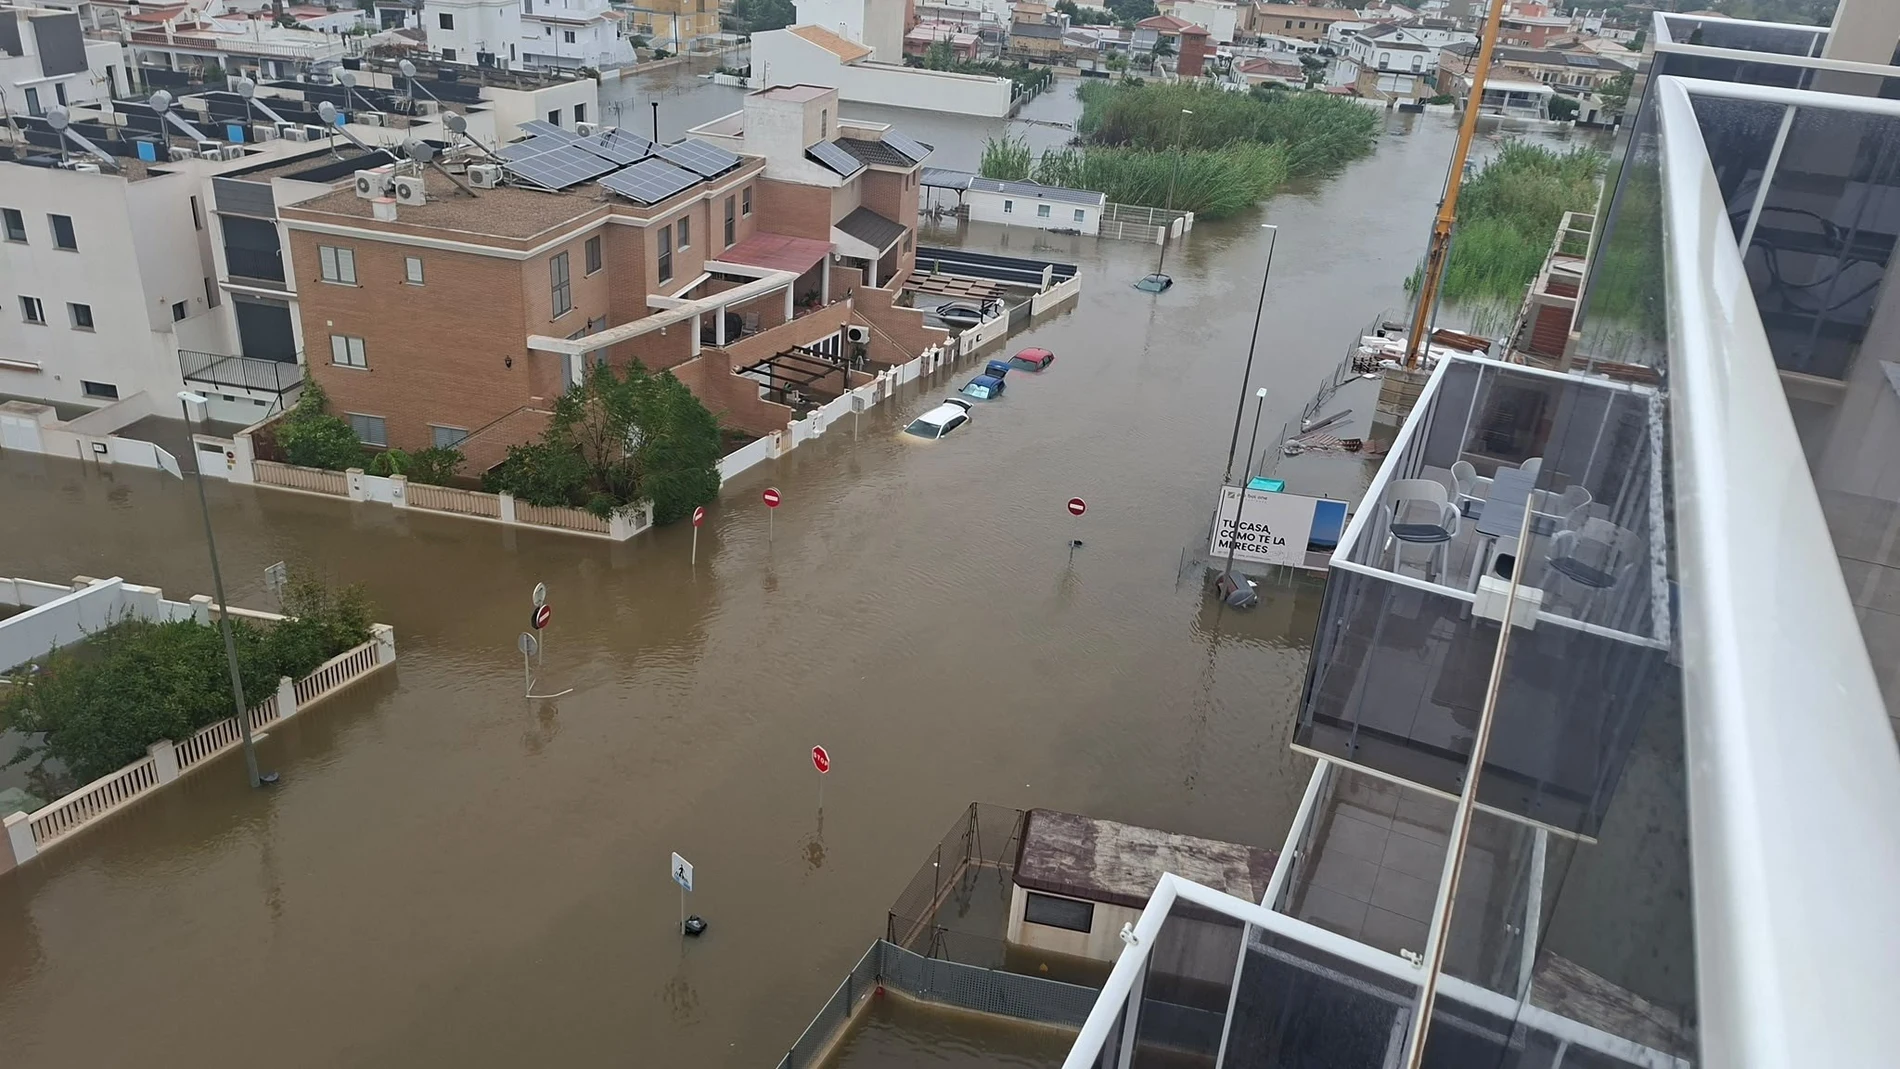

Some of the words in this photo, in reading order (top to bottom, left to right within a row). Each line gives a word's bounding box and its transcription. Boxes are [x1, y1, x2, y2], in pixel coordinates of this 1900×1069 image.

[1223, 519, 1236, 528] TU
[1239, 522, 1271, 535] CASA,
[1258, 535, 1271, 544] TE
[1273, 537, 1286, 546] LA
[814, 752, 828, 766] STOP
